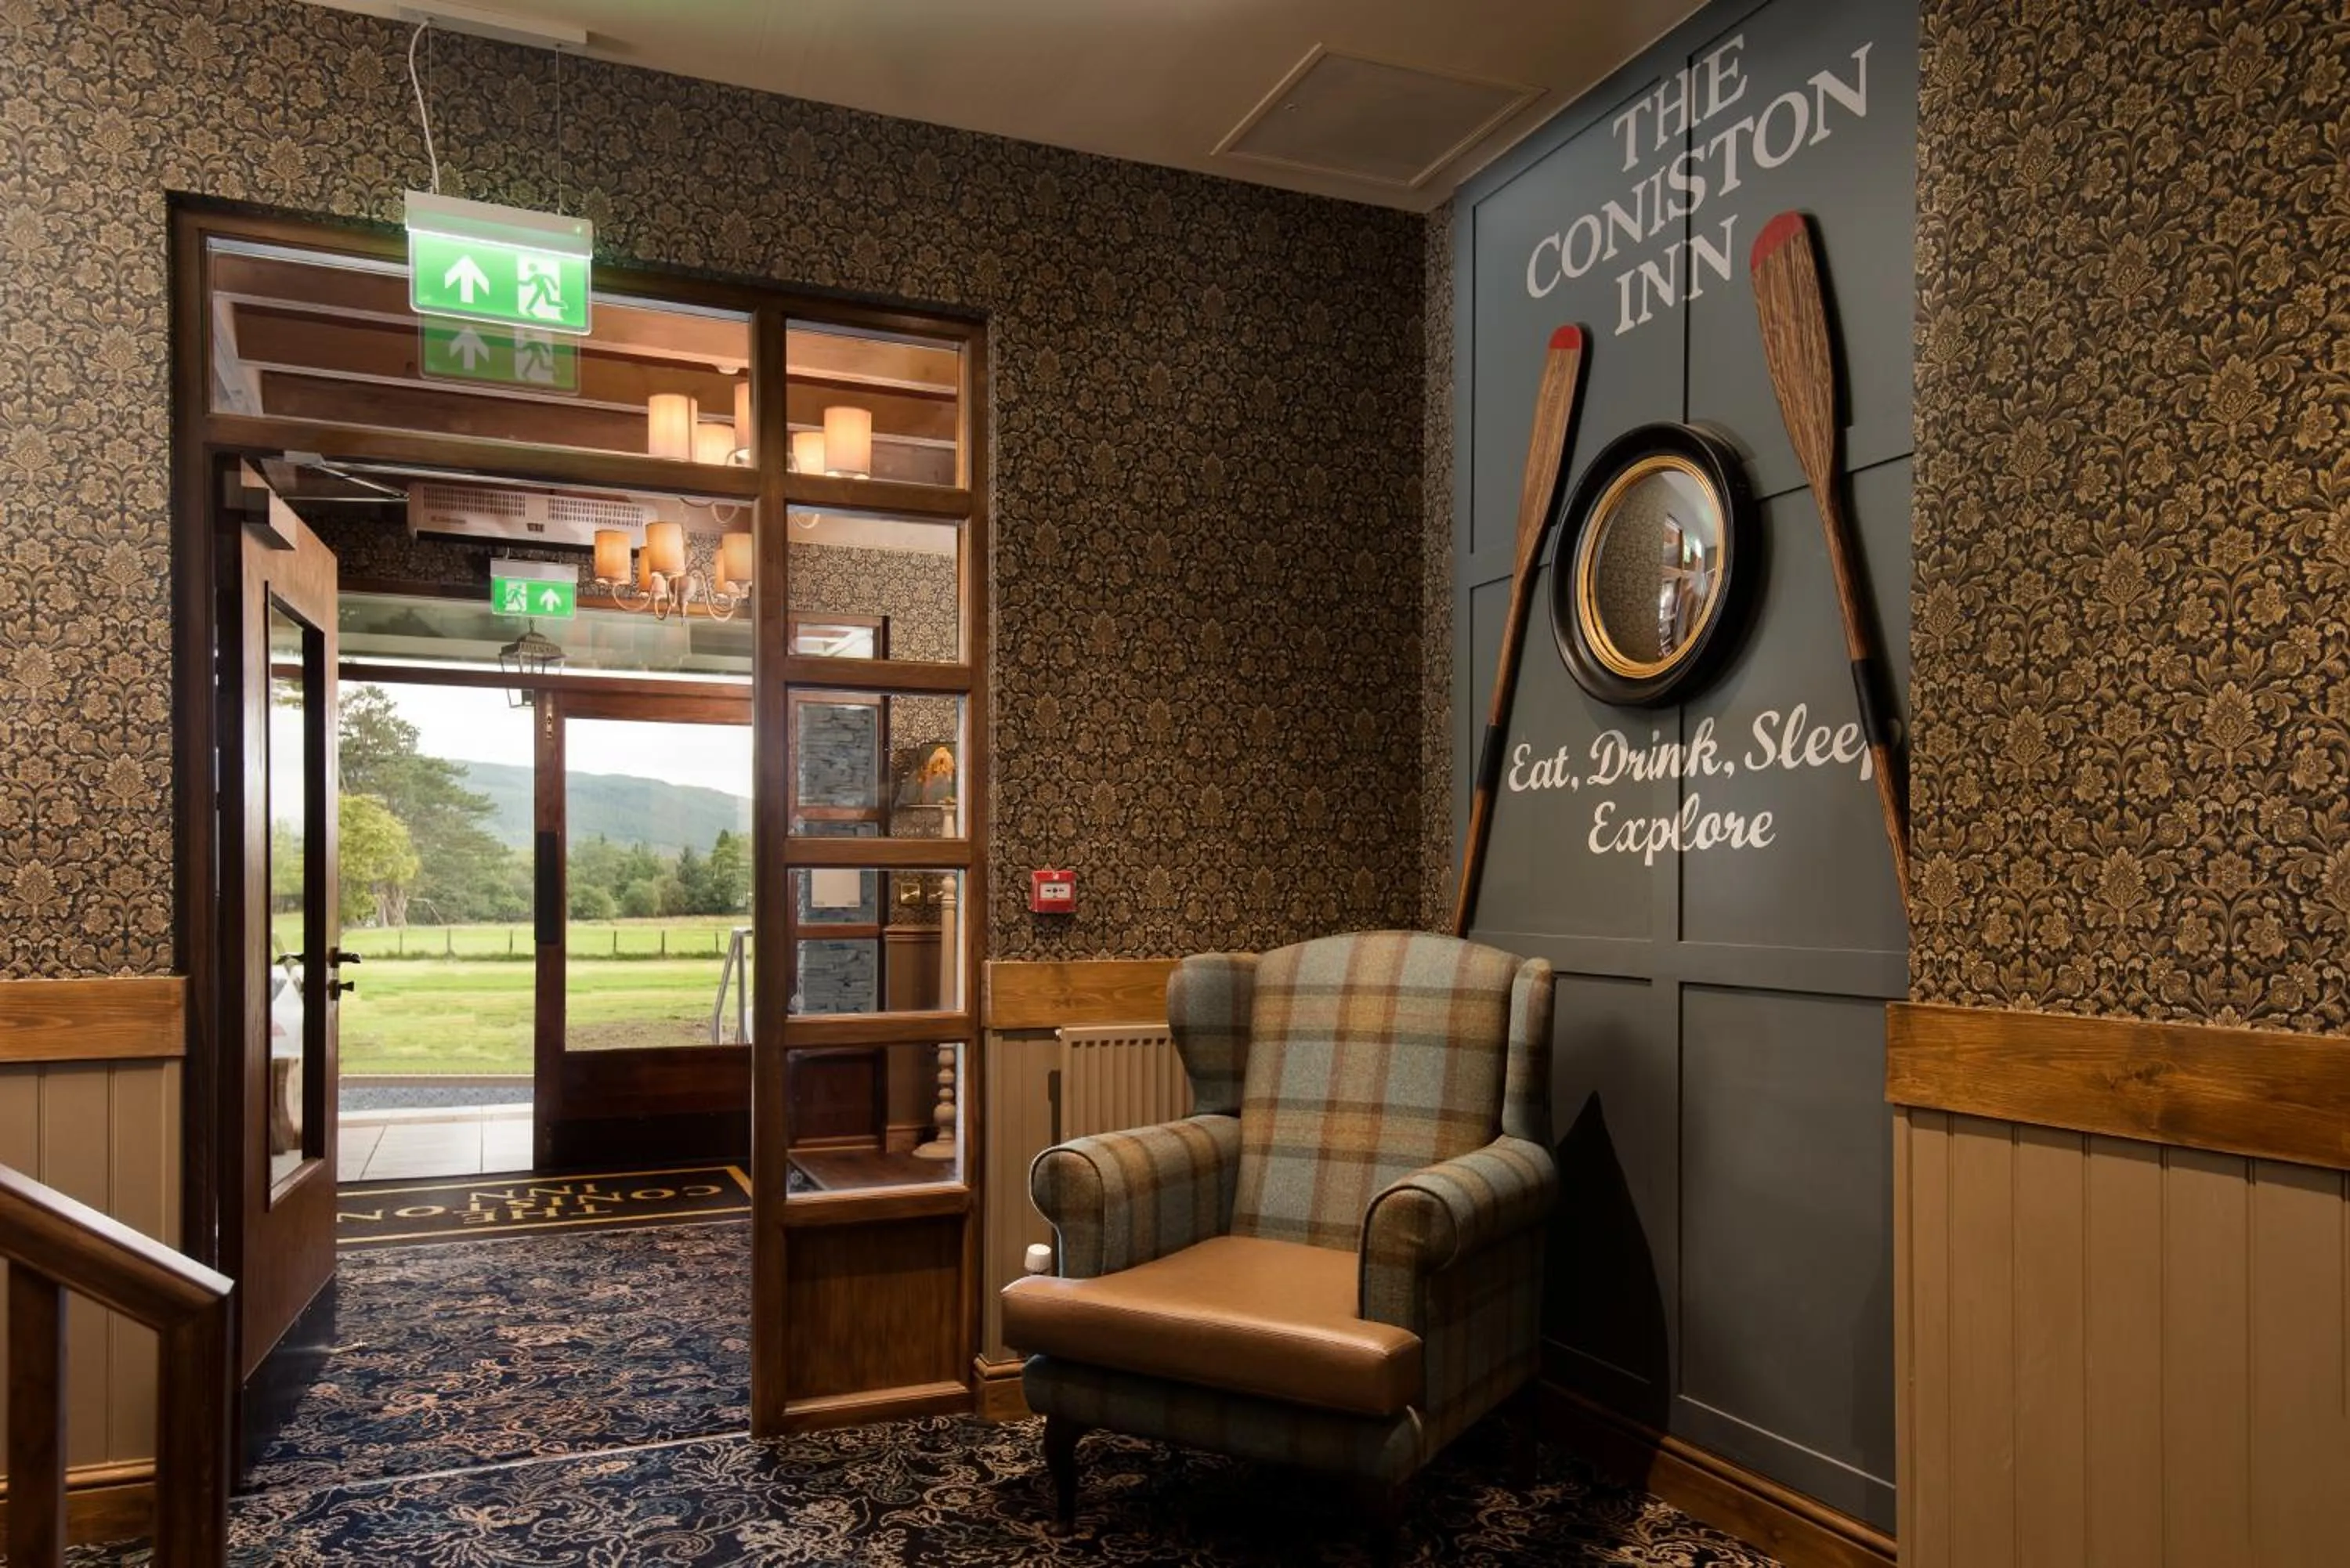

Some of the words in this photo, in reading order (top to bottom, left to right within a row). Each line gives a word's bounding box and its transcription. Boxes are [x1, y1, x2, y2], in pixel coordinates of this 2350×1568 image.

[1613, 34, 1748, 172] THE
[1527, 42, 1874, 299] CONISTON
[1614, 214, 1738, 336] INN
[1509, 743, 1578, 792] Eat,
[1586, 717, 1734, 785] Drink,
[1588, 792, 1777, 866] Explore
